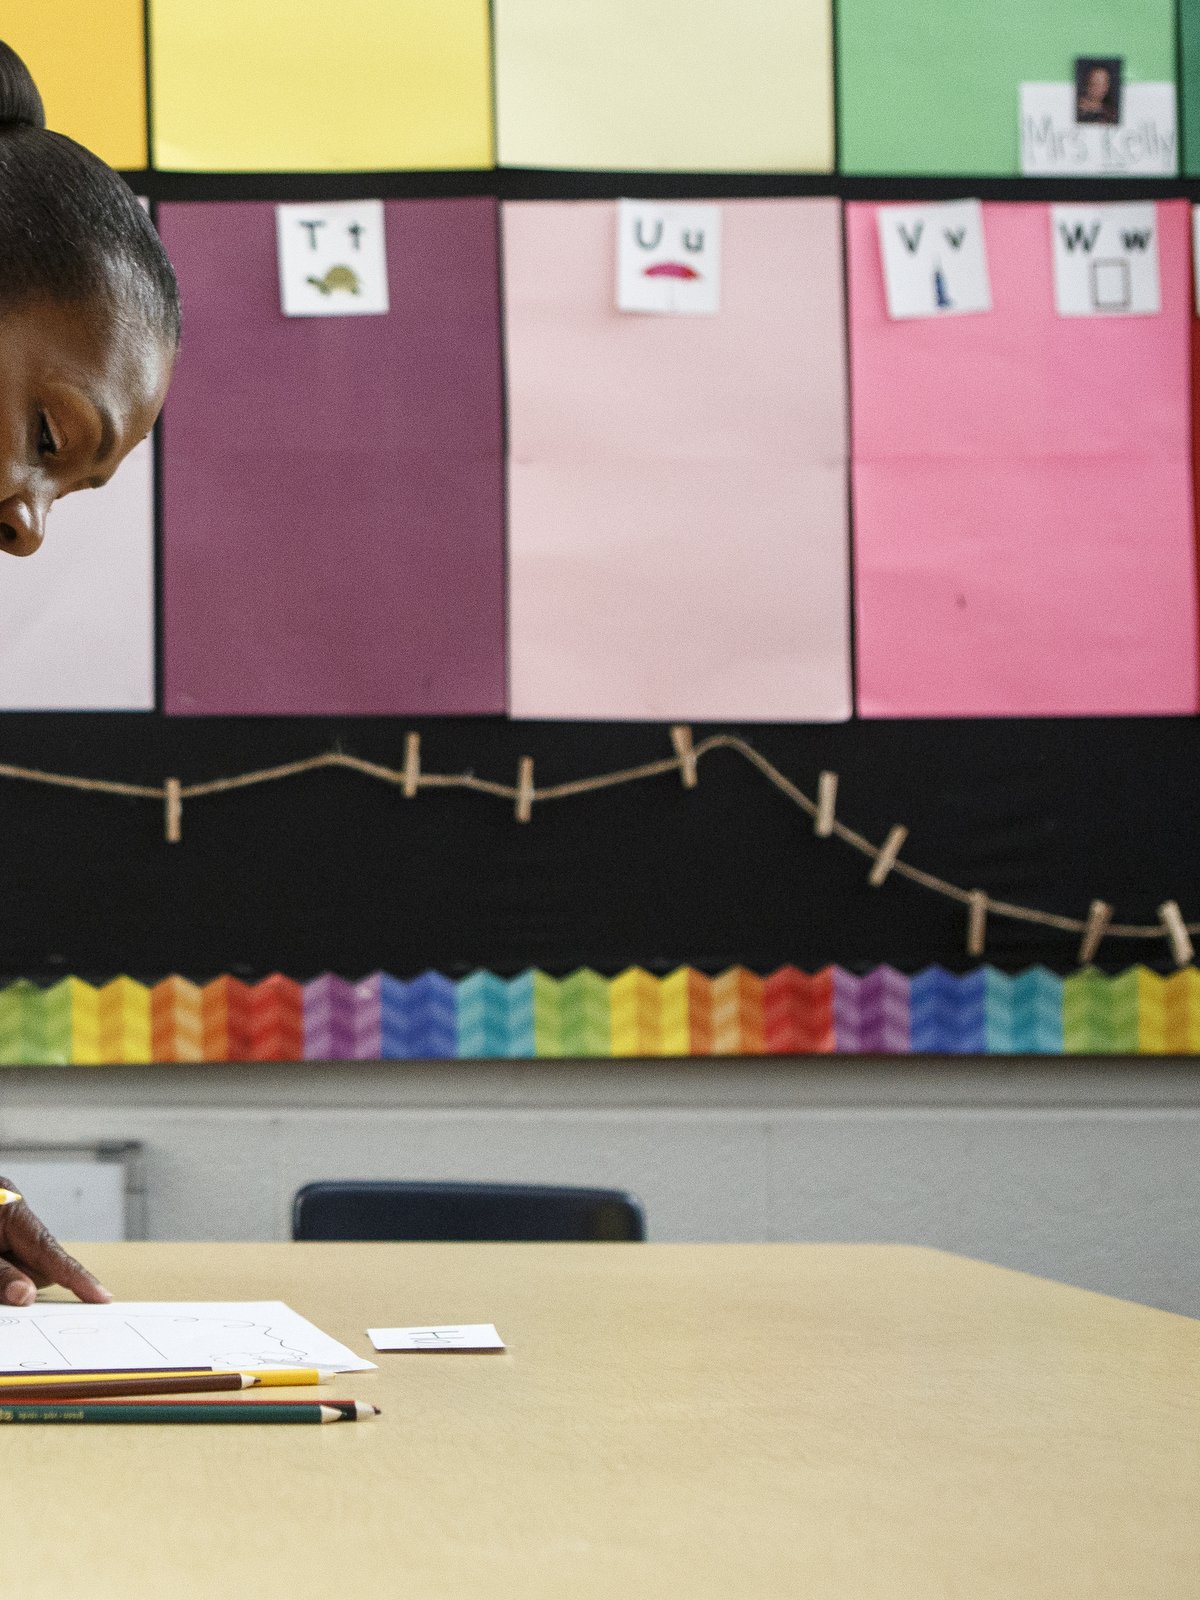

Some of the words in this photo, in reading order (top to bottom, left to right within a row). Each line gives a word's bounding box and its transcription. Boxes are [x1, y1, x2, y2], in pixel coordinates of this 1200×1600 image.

[298, 218, 326, 252] T
[347, 214, 365, 252] t
[633, 216, 664, 250] U
[682, 229, 704, 252] u
[897, 219, 924, 254] V
[943, 226, 966, 251] v
[1059, 221, 1100, 252] W
[1120, 229, 1152, 252] w
